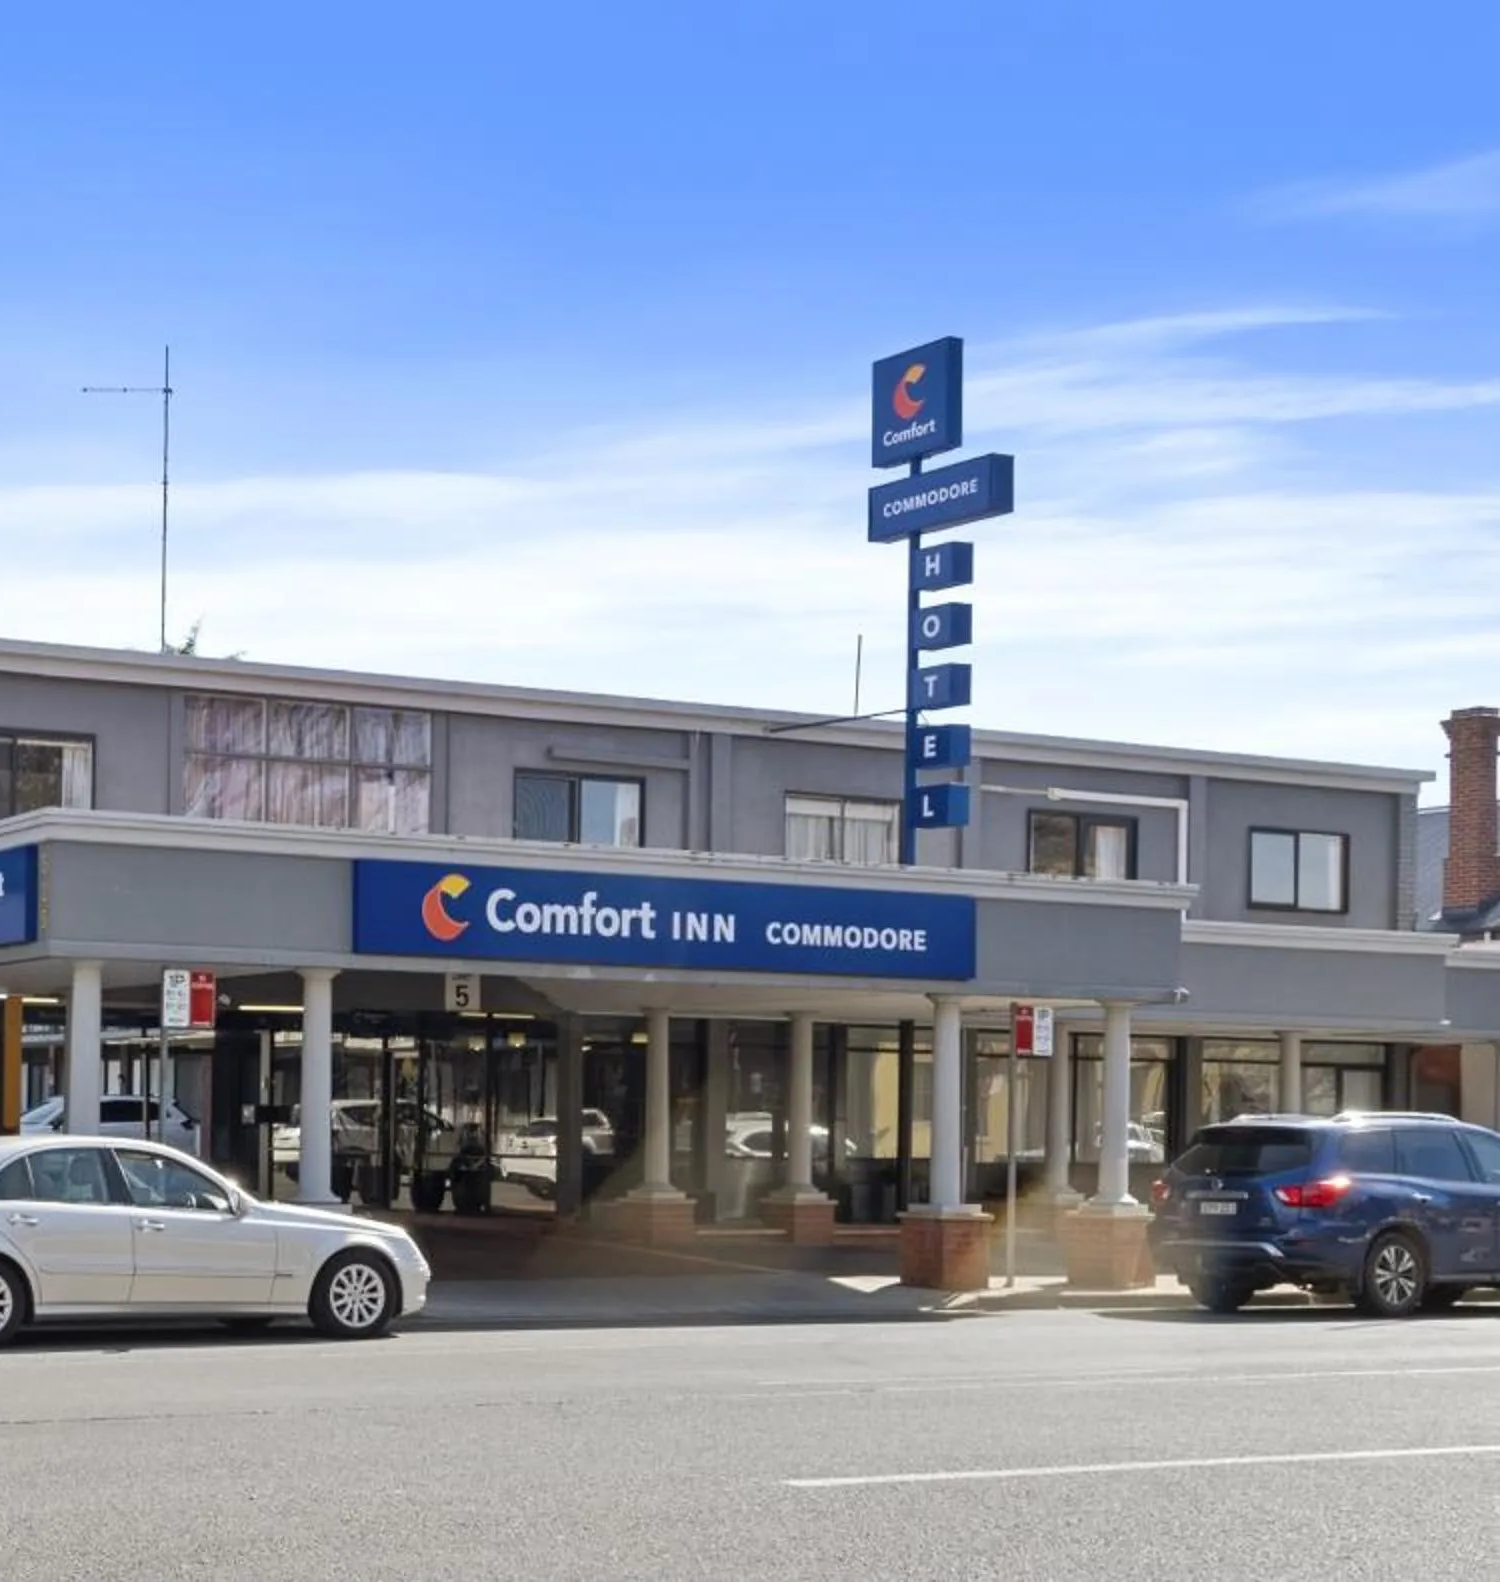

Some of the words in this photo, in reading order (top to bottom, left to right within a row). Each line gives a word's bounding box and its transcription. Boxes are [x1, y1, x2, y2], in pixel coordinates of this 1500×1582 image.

[883, 419, 936, 447] Comfort
[883, 478, 979, 518] COMMODORE
[921, 553, 941, 818] HOTEL
[486, 888, 656, 940] Comfort
[672, 911, 736, 944] INN
[765, 921, 927, 952] COMMODORE
[455, 984, 470, 1008] 5
